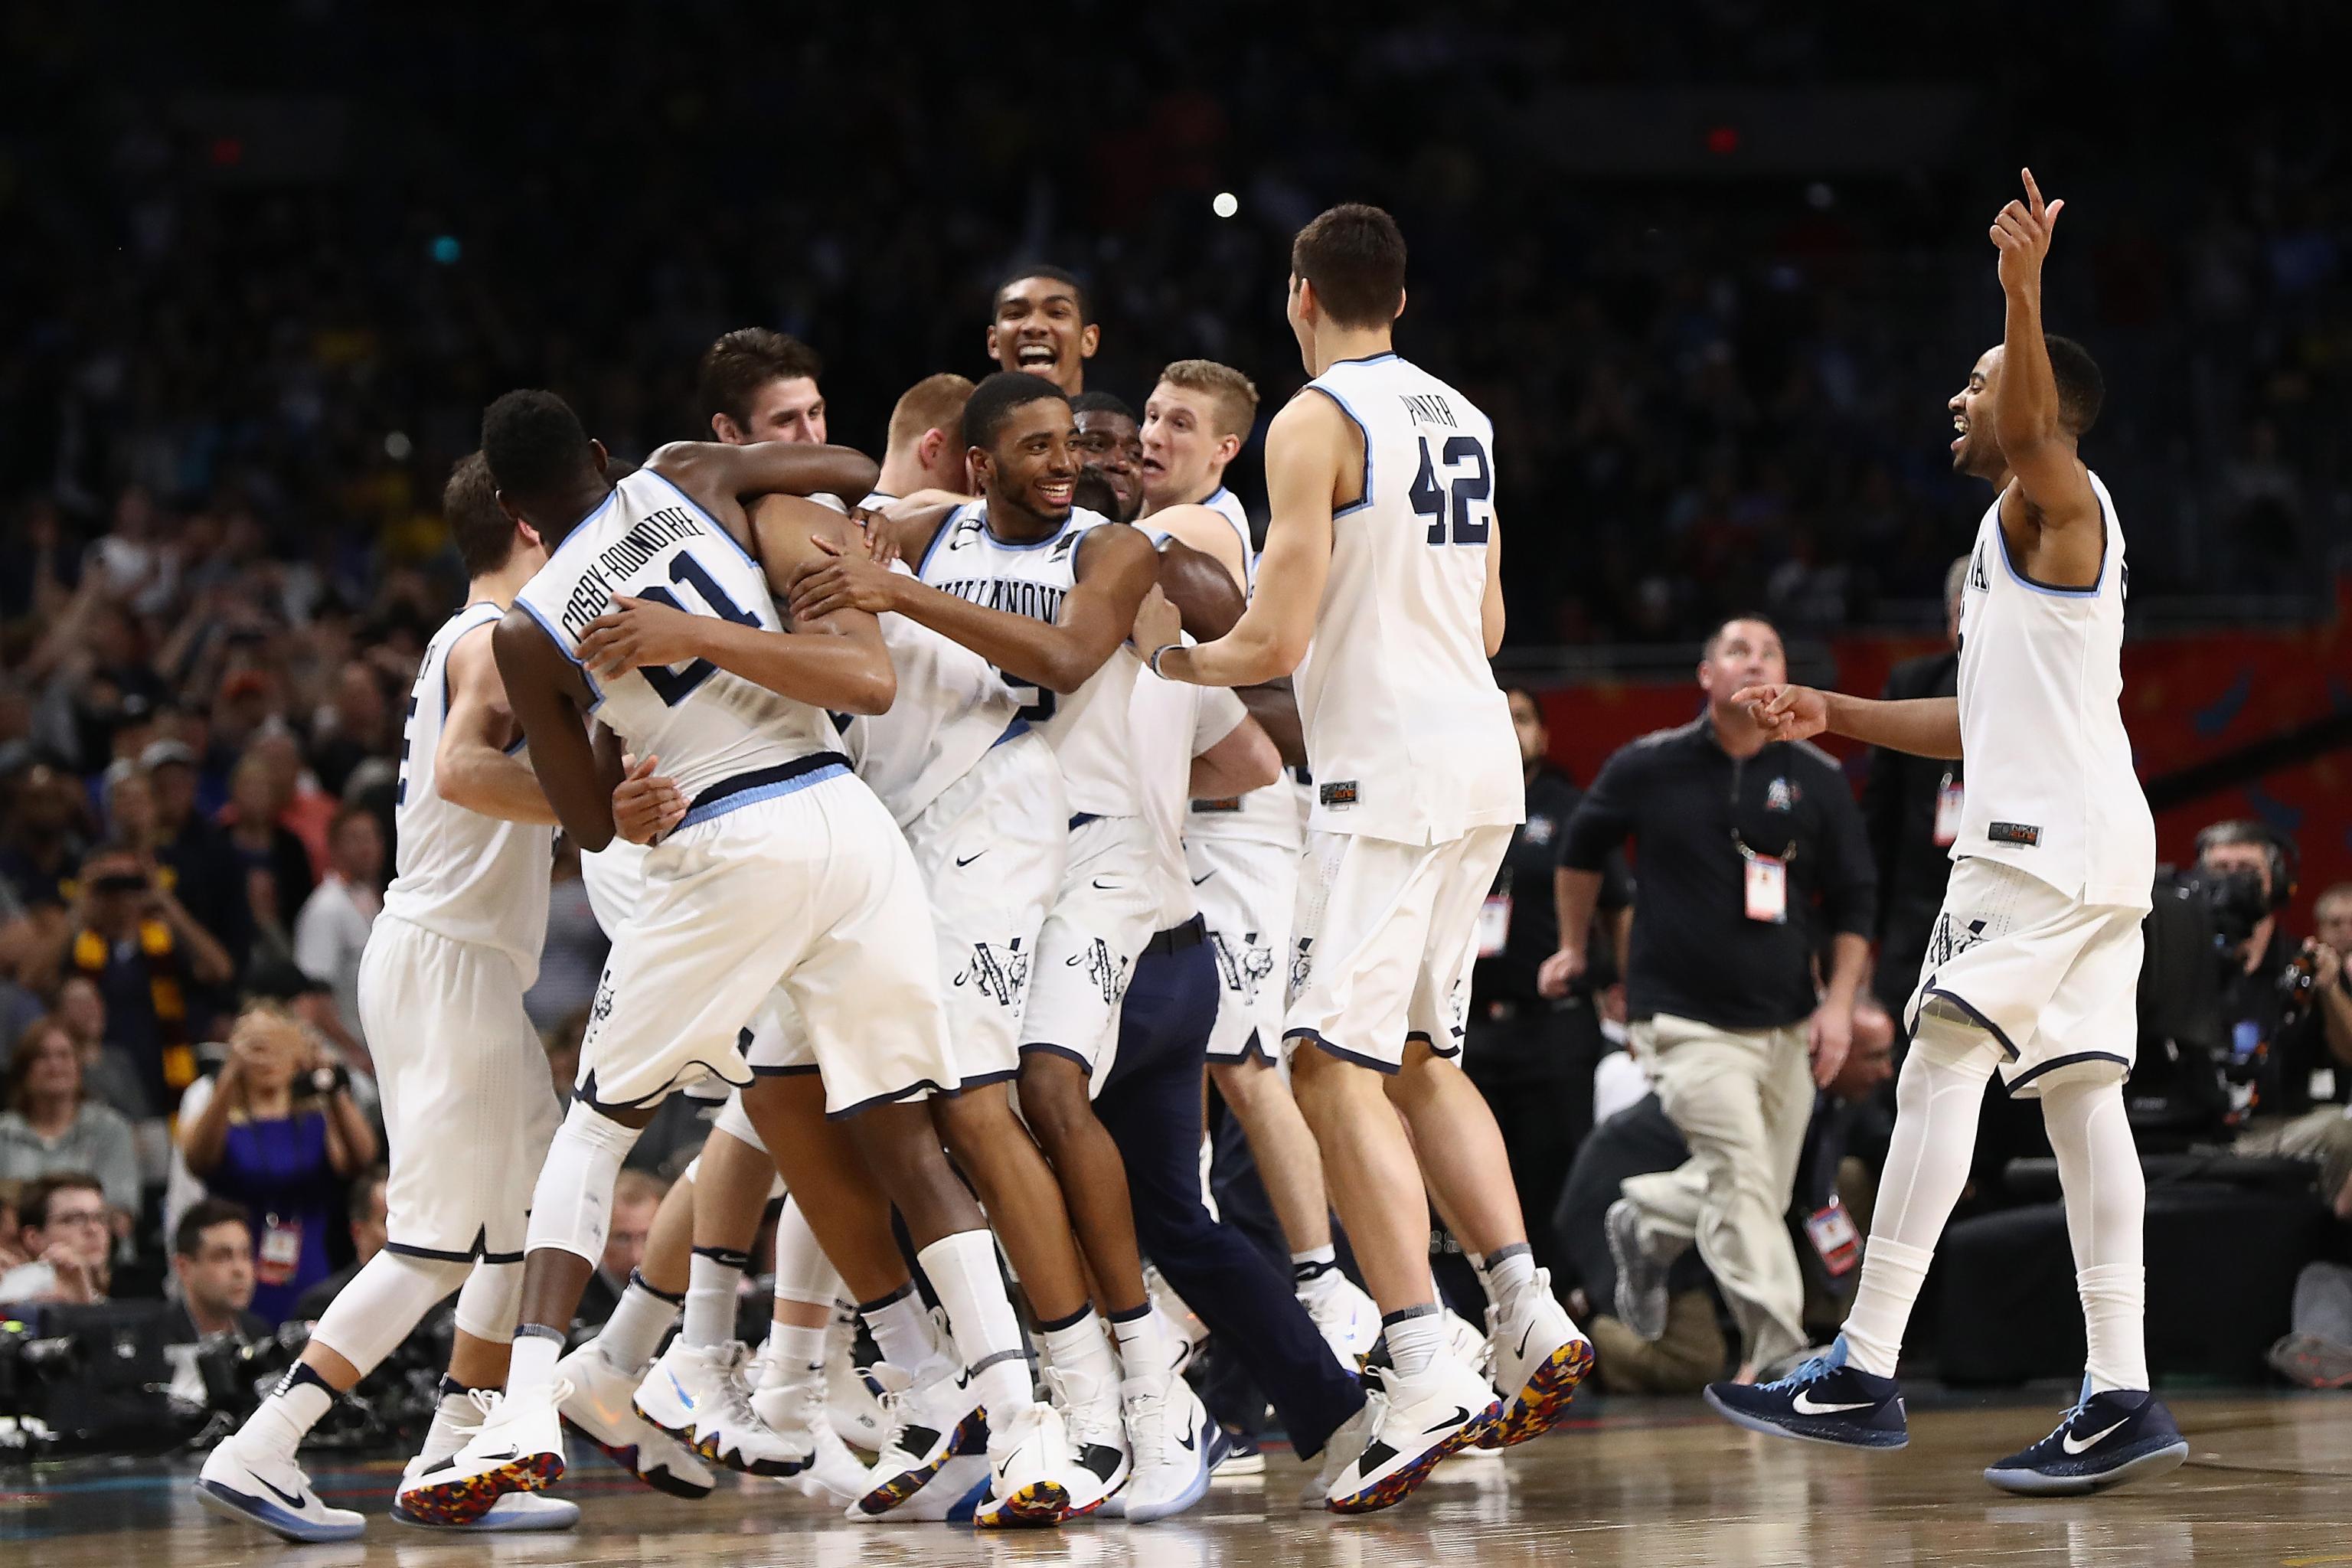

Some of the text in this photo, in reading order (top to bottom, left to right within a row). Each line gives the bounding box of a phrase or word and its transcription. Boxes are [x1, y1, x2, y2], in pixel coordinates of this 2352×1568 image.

[1409, 436, 1491, 546] 42
[562, 506, 706, 645] COSBY-ROUNDTREE
[619, 550, 763, 707] 21
